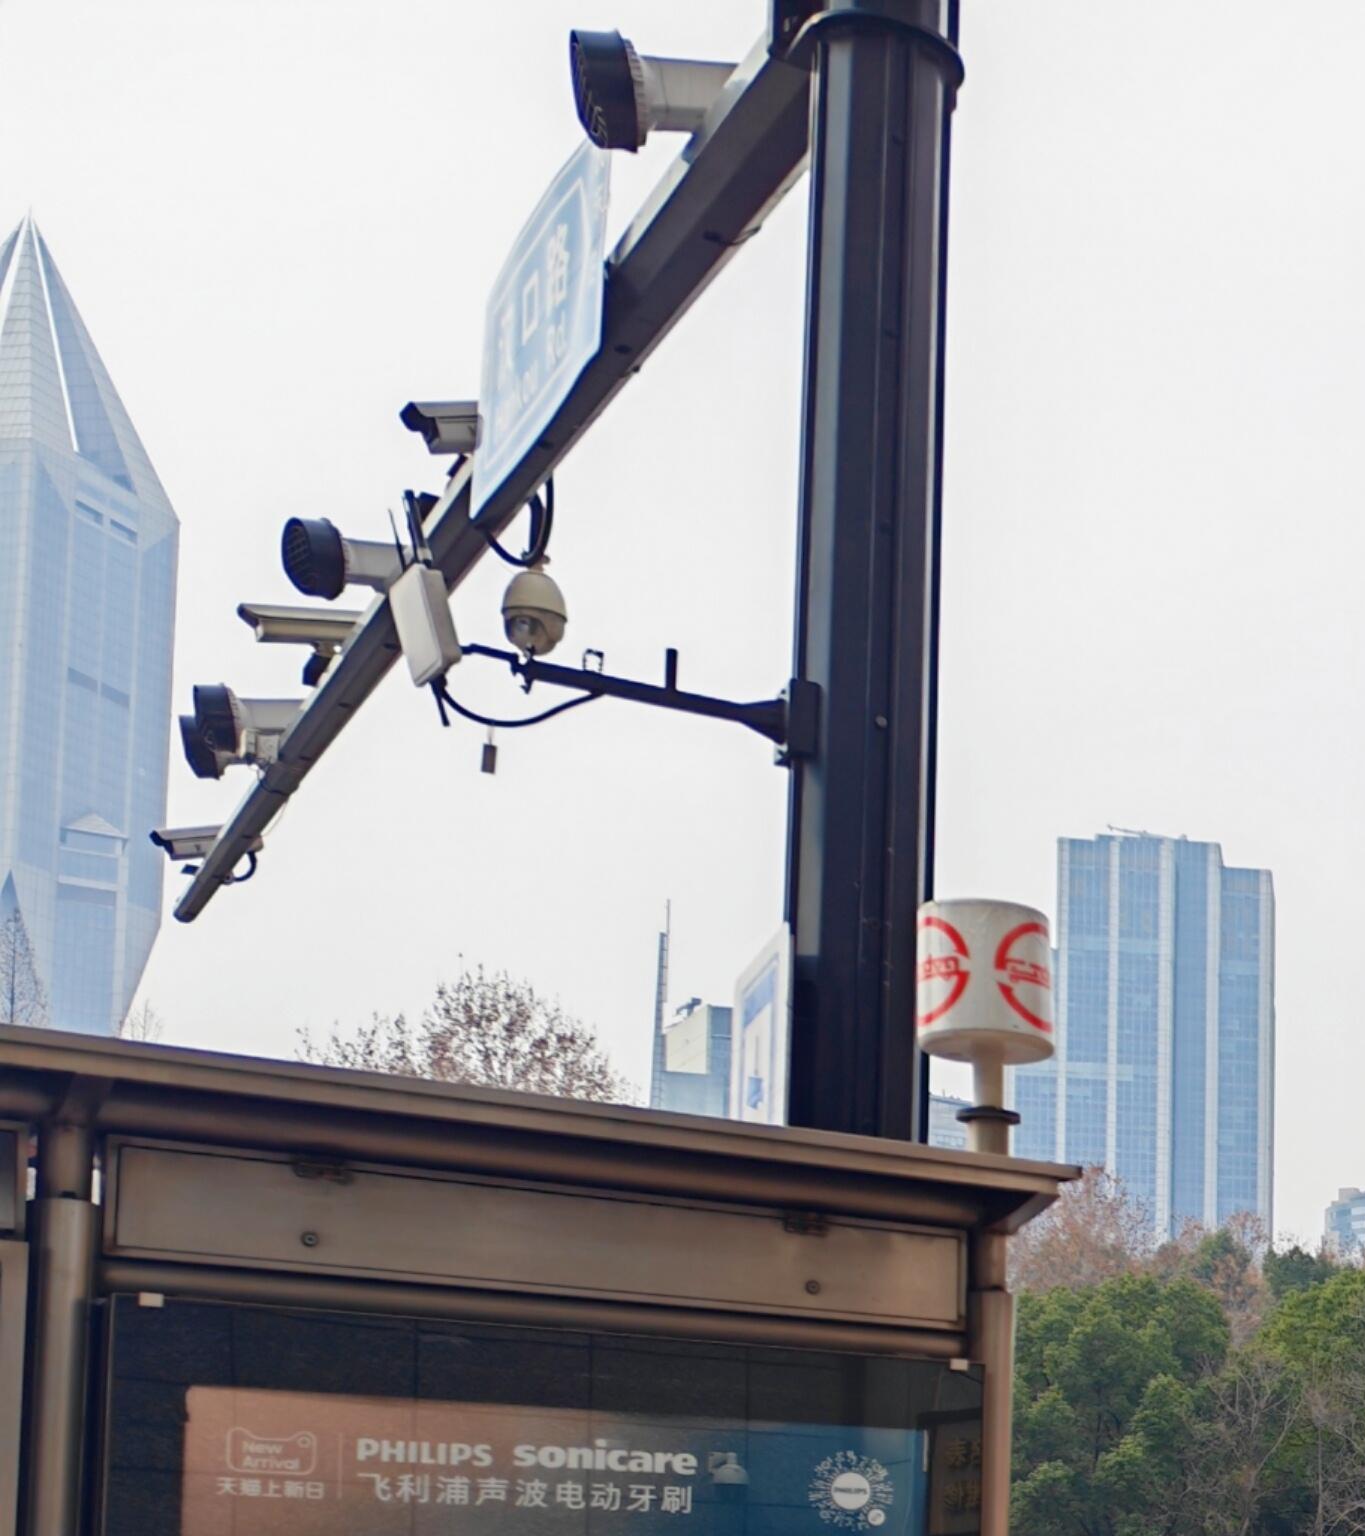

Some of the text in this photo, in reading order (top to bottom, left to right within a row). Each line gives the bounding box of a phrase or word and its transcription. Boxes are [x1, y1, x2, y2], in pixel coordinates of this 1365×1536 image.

[242, 1441, 284, 1454] New
[357, 1437, 698, 1476] PHILIPS sonicare
[242, 1456, 300, 1470] Arrival
[216, 1477, 325, 1500] 天猫上新日
[357, 1472, 693, 1514] 飞利浦声波电动牙刷
